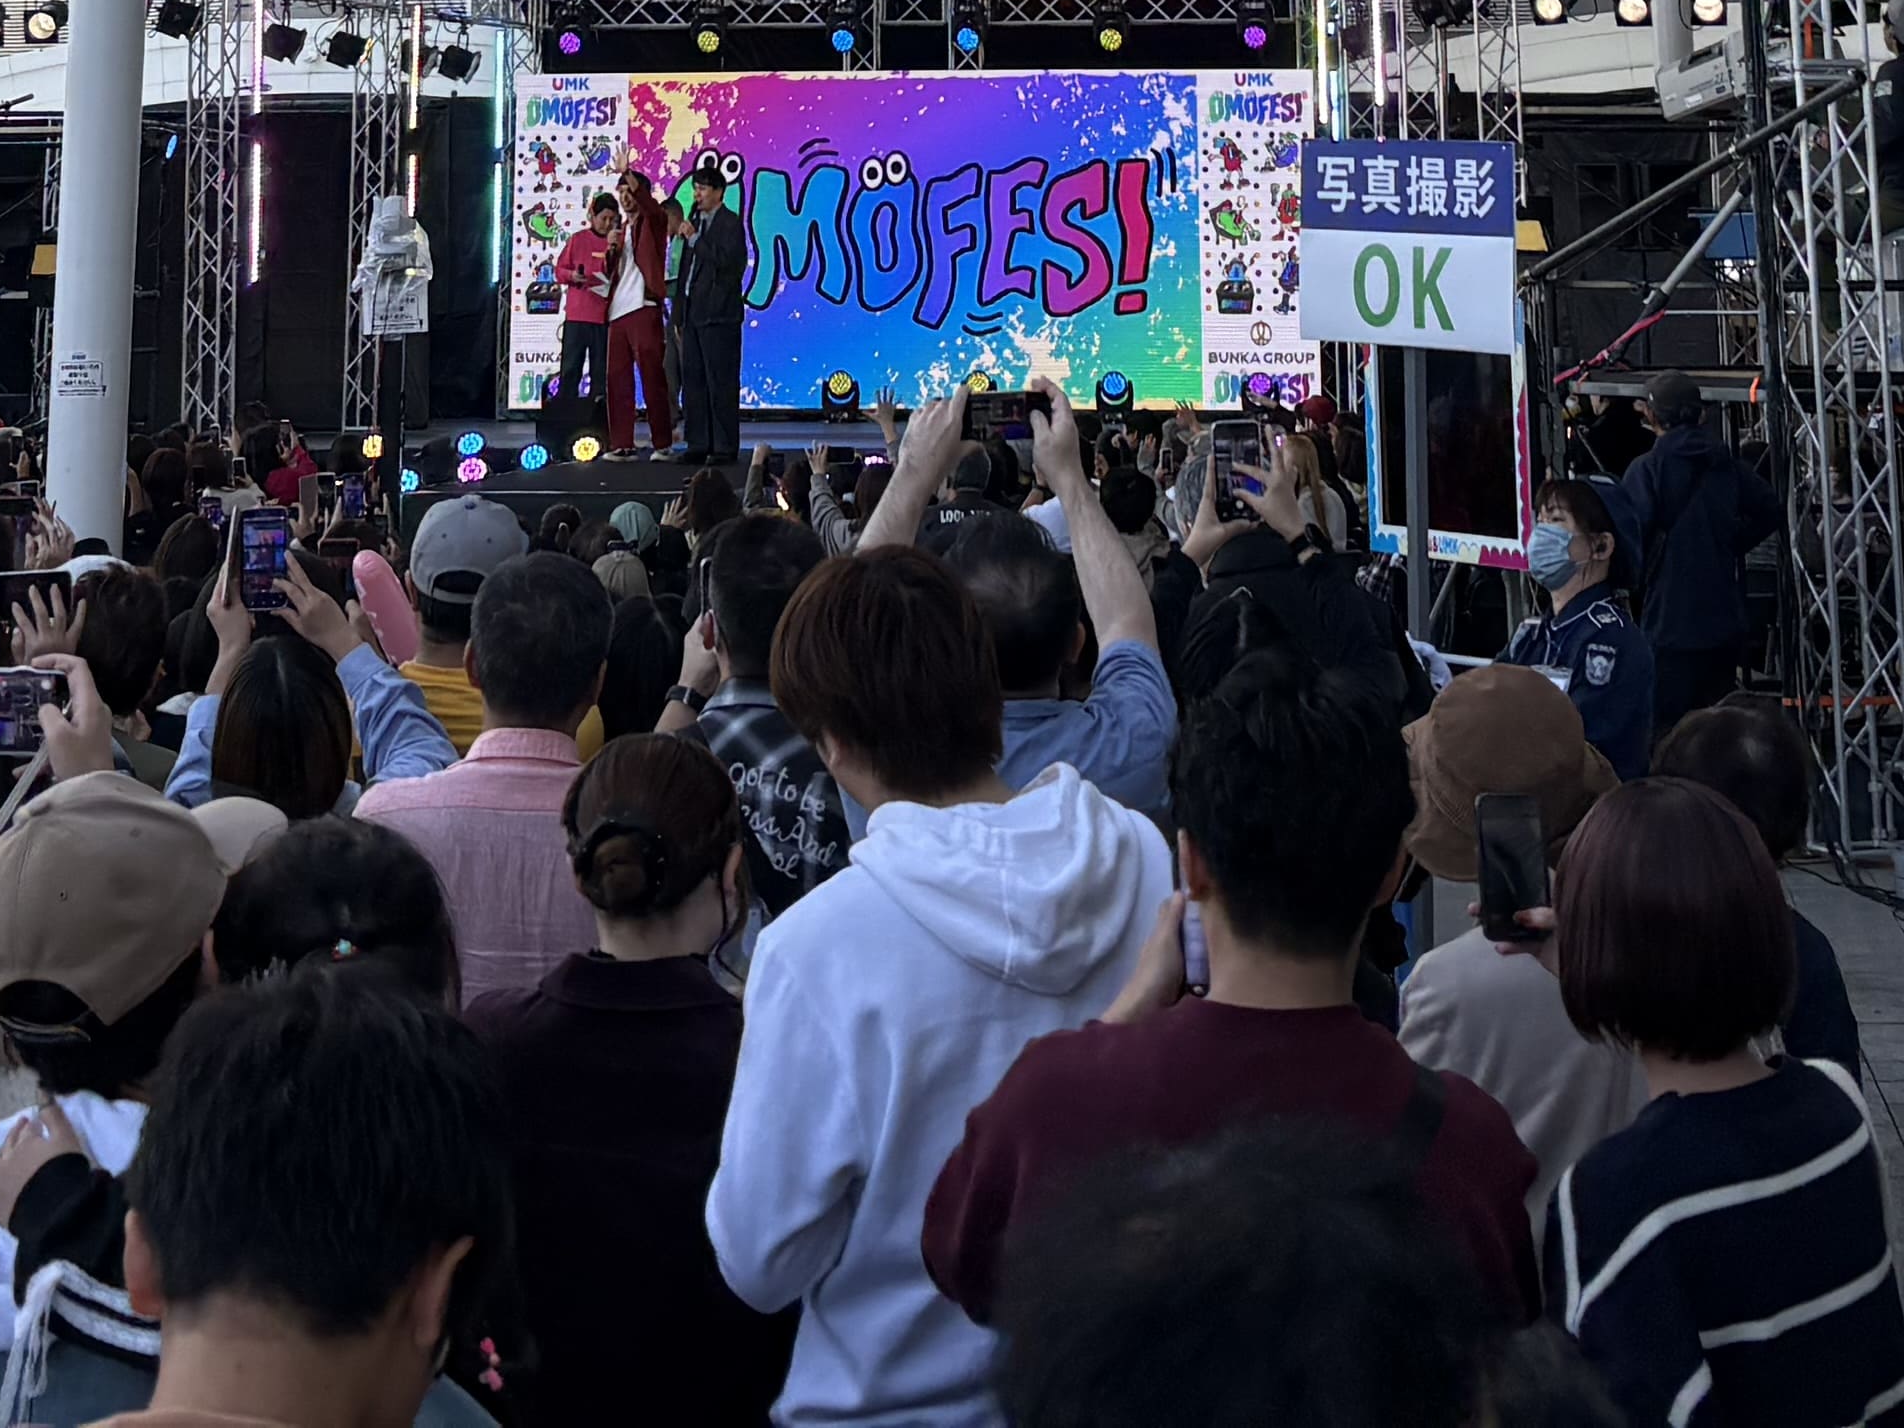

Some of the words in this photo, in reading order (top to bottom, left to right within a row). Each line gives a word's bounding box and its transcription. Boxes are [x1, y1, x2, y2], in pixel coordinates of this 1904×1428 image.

[552, 77, 590, 91] UMK
[1234, 73, 1274, 87] UMK
[1316, 154, 1496, 219] 写真撮影
[1353, 242, 1455, 332] OK
[1208, 351, 1261, 364] BUNKA
[1263, 351, 1315, 364] GROUP
[775, 766, 798, 801] to
[800, 784, 826, 822] be
